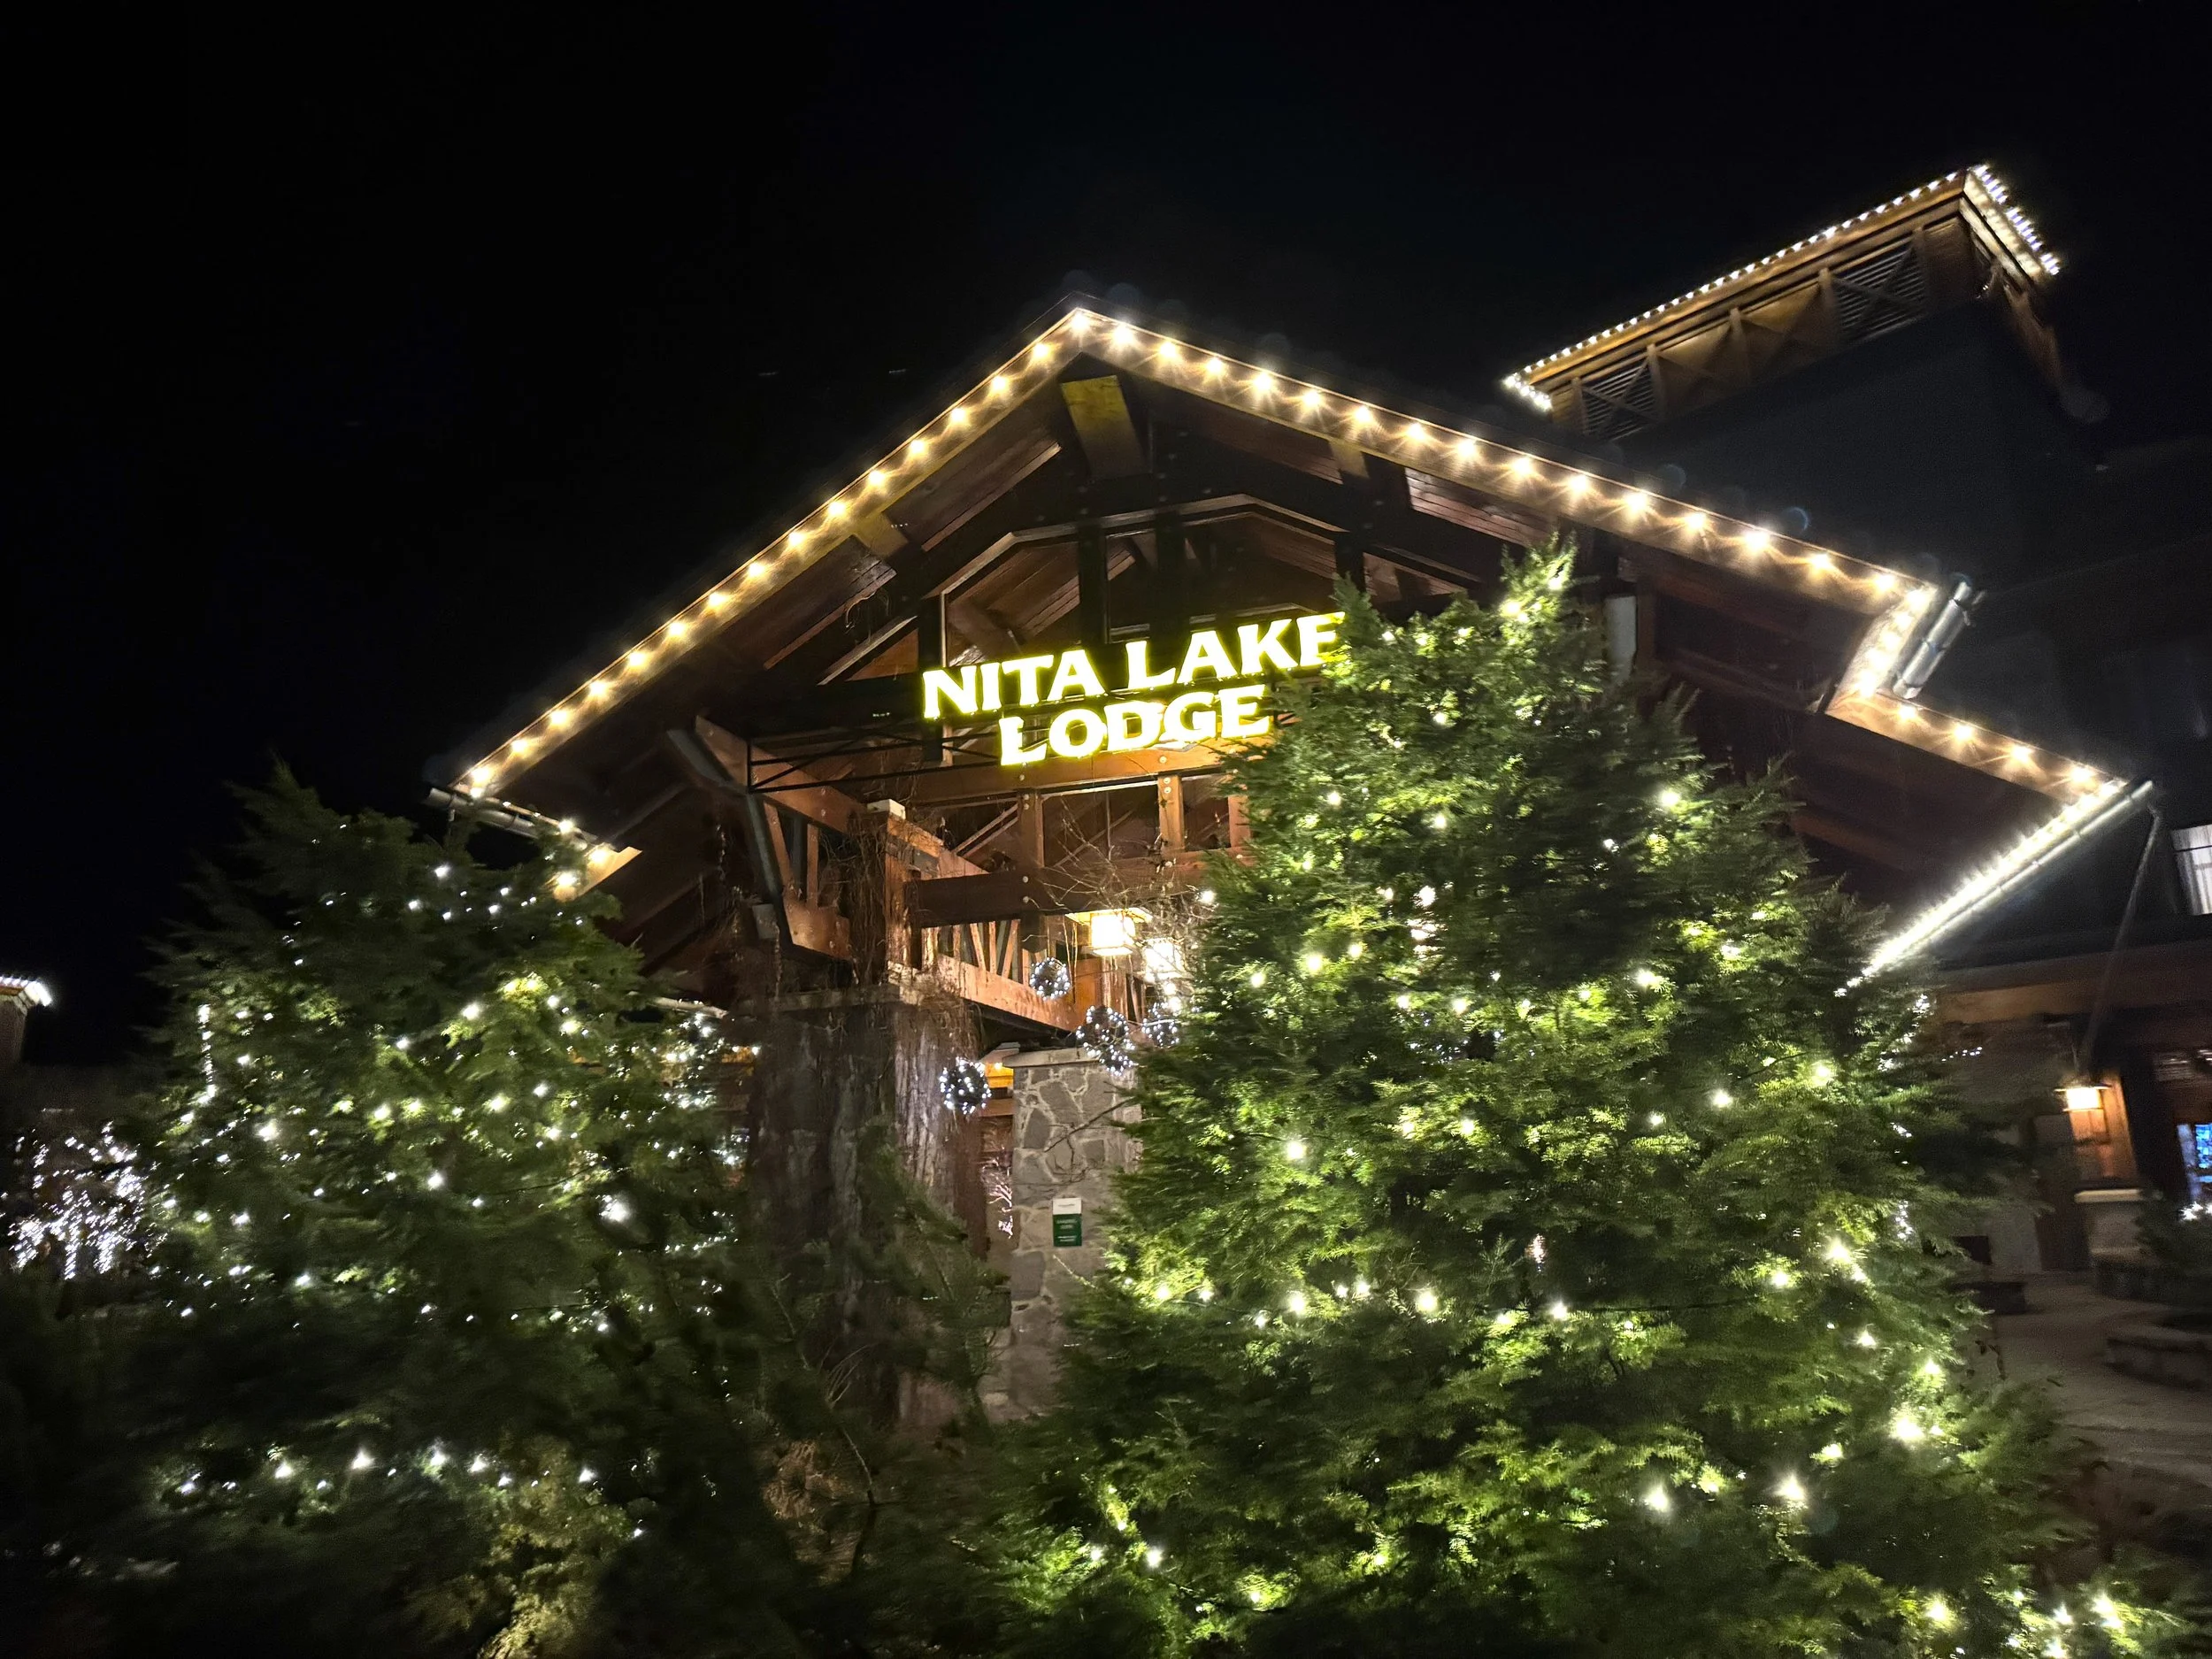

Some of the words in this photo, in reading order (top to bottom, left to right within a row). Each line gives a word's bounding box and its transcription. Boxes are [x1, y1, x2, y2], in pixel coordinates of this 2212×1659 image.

[923, 649, 1104, 719] NITA
[1125, 611, 1346, 690] LAKE
[1000, 684, 1270, 766] LODGE
